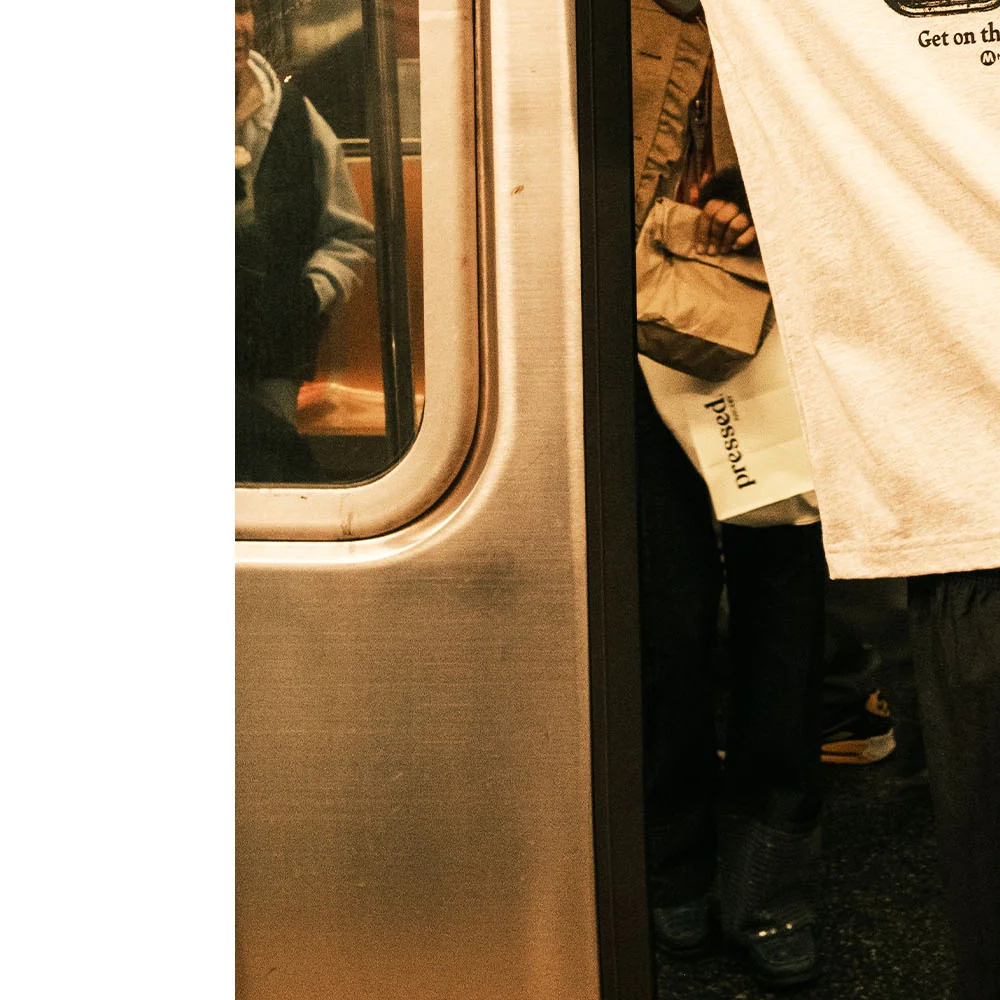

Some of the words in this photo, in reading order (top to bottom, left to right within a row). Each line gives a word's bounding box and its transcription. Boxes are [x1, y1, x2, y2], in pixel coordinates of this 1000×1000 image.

[918, 30, 949, 47] Get
[953, 31, 976, 45] on
[704, 398, 757, 489] pressed
